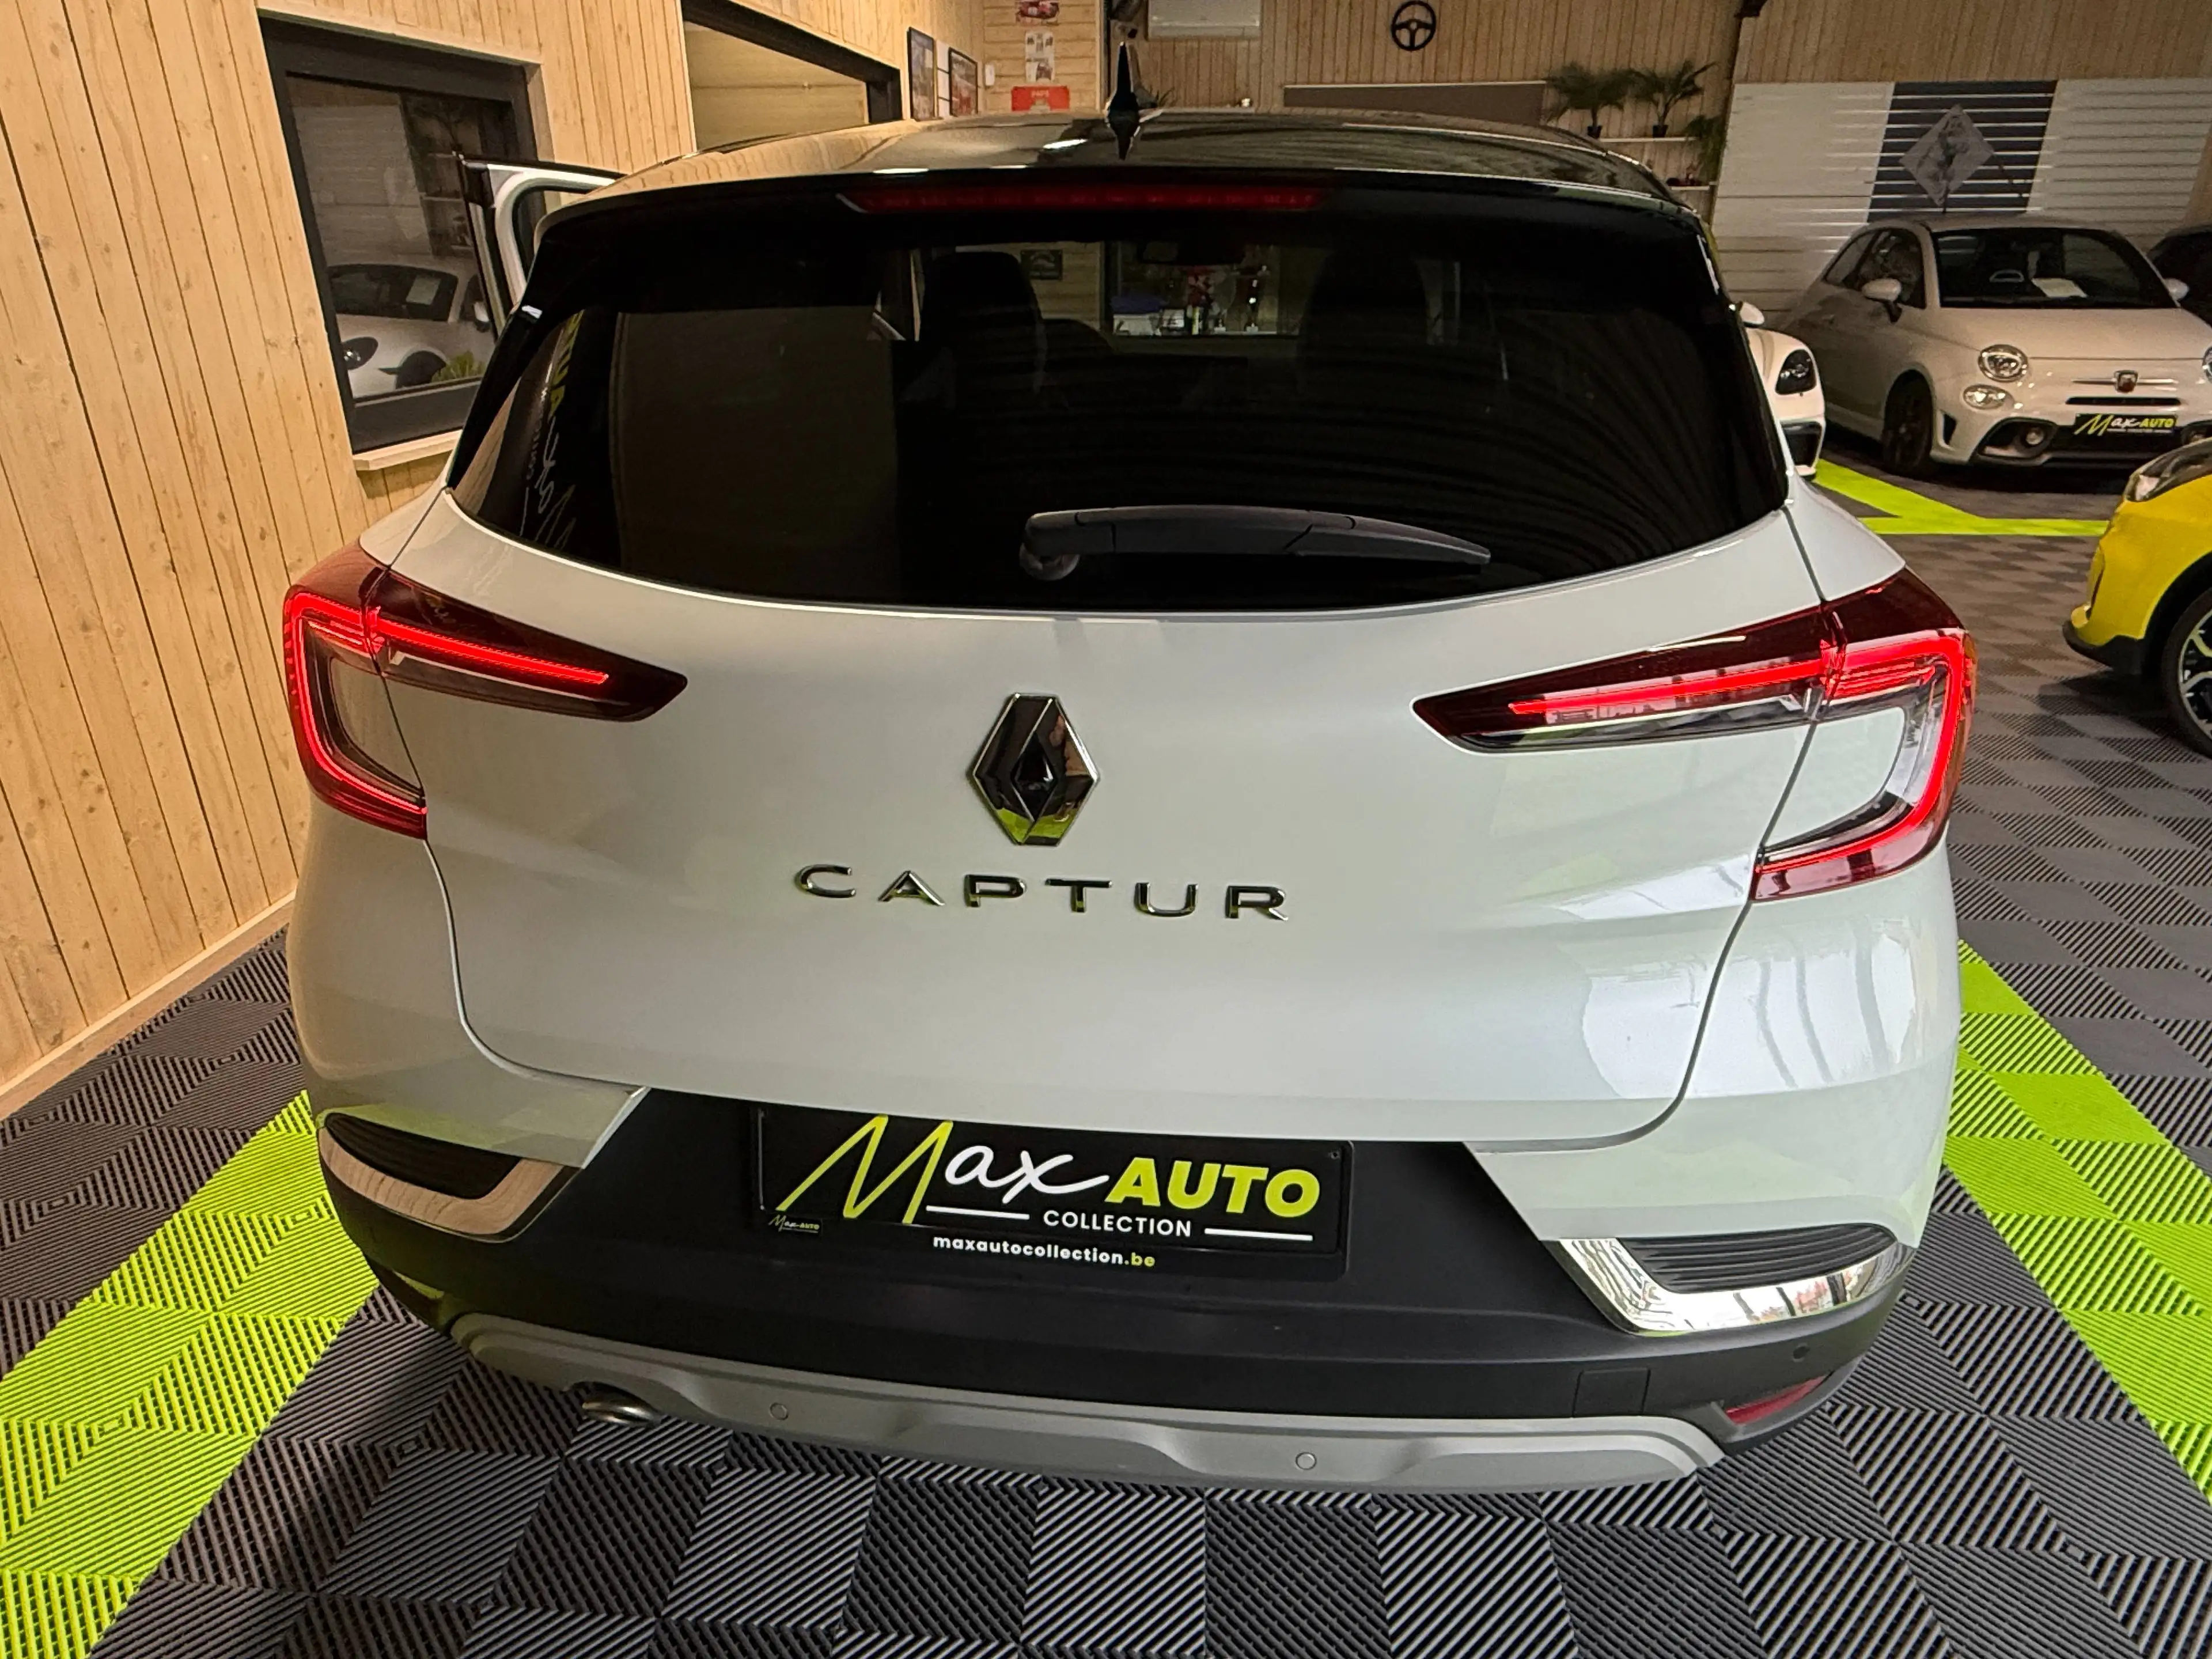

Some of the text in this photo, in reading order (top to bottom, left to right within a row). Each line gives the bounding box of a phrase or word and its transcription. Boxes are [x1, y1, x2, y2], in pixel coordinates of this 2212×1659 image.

[2075, 414, 2175, 435] Max AUTO
[794, 863, 1289, 922] CAPTUR
[775, 1113, 1320, 1225] Max AUTO
[1043, 1210, 1192, 1237] COLLECTION
[933, 1236, 1156, 1267] maxautocollection.be
